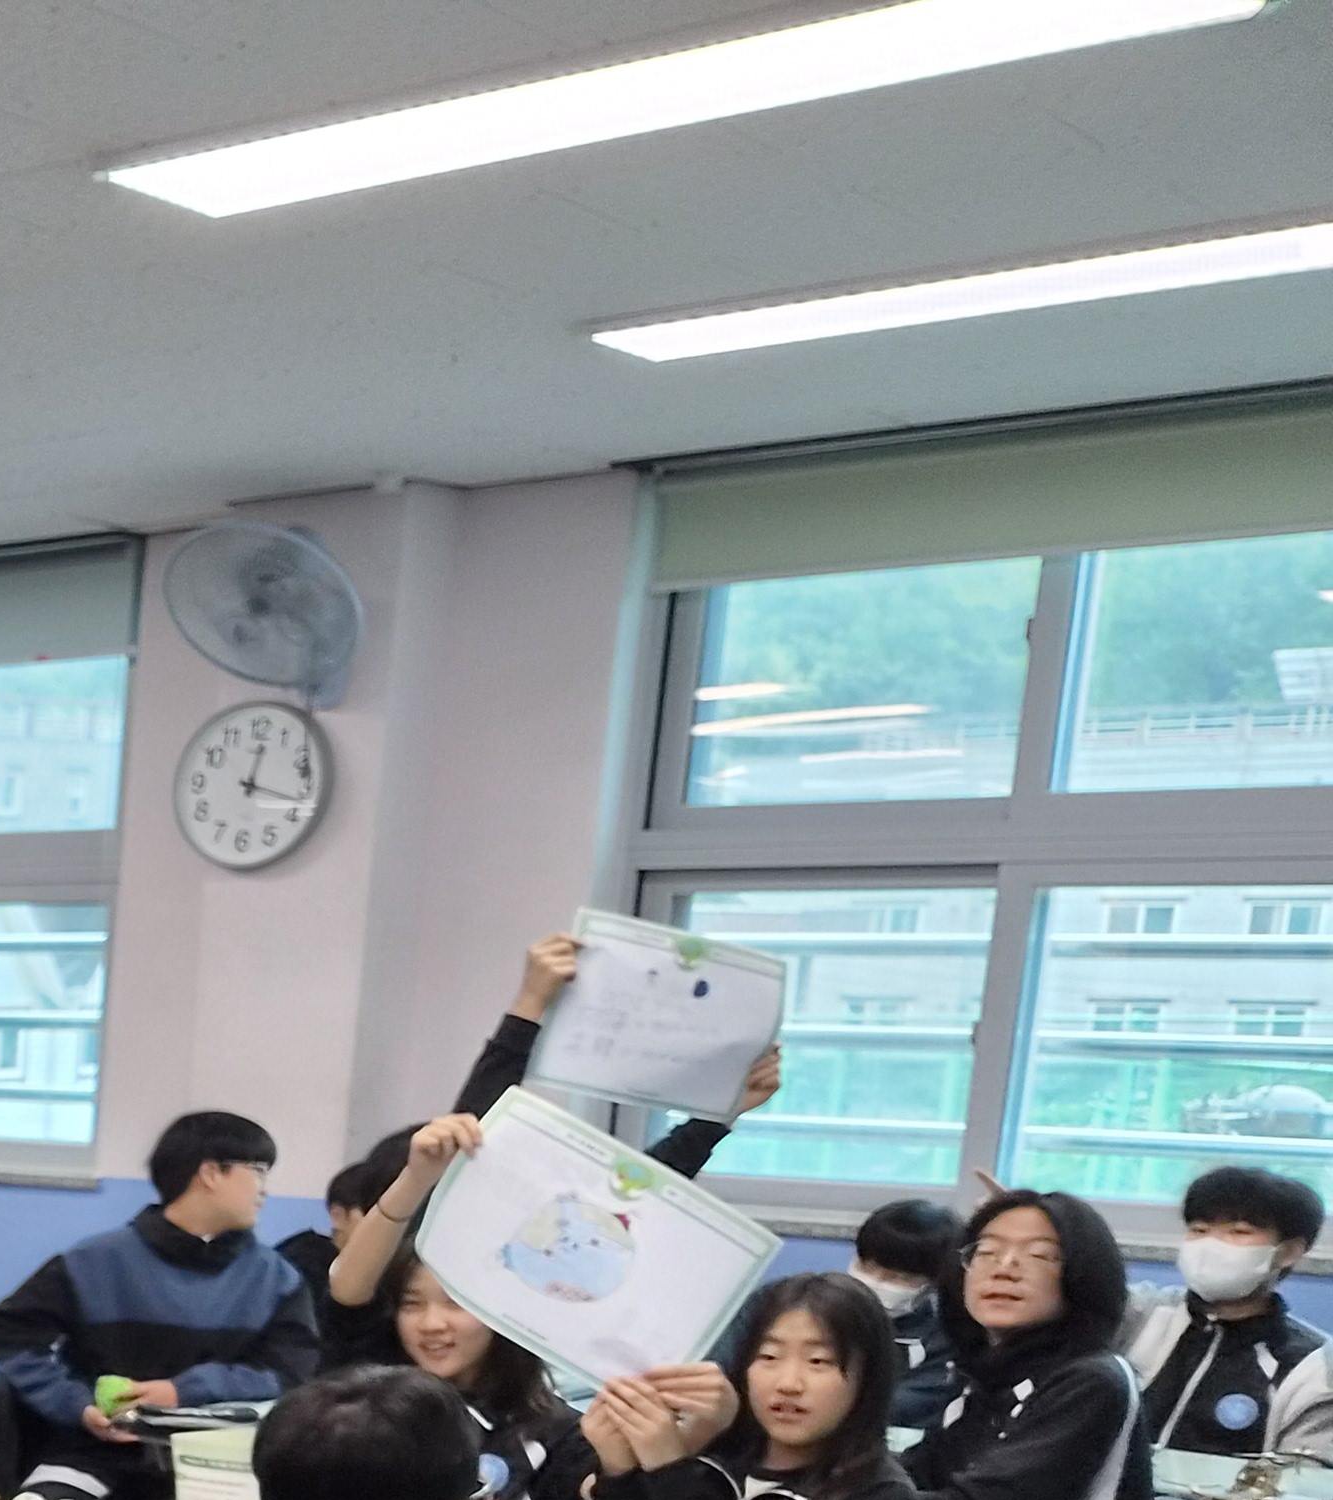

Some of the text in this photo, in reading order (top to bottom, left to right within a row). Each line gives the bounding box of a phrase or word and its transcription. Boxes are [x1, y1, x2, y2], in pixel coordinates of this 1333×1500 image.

[224, 724, 241, 748] 11
[252, 716, 273, 741] 12
[281, 728, 289, 747] 1
[205, 745, 227, 769] 10
[191, 771, 207, 794] 9
[194, 798, 209, 822] 8
[214, 820, 228, 844] 7
[235, 829, 251, 853] 6
[261, 825, 278, 847] 5
